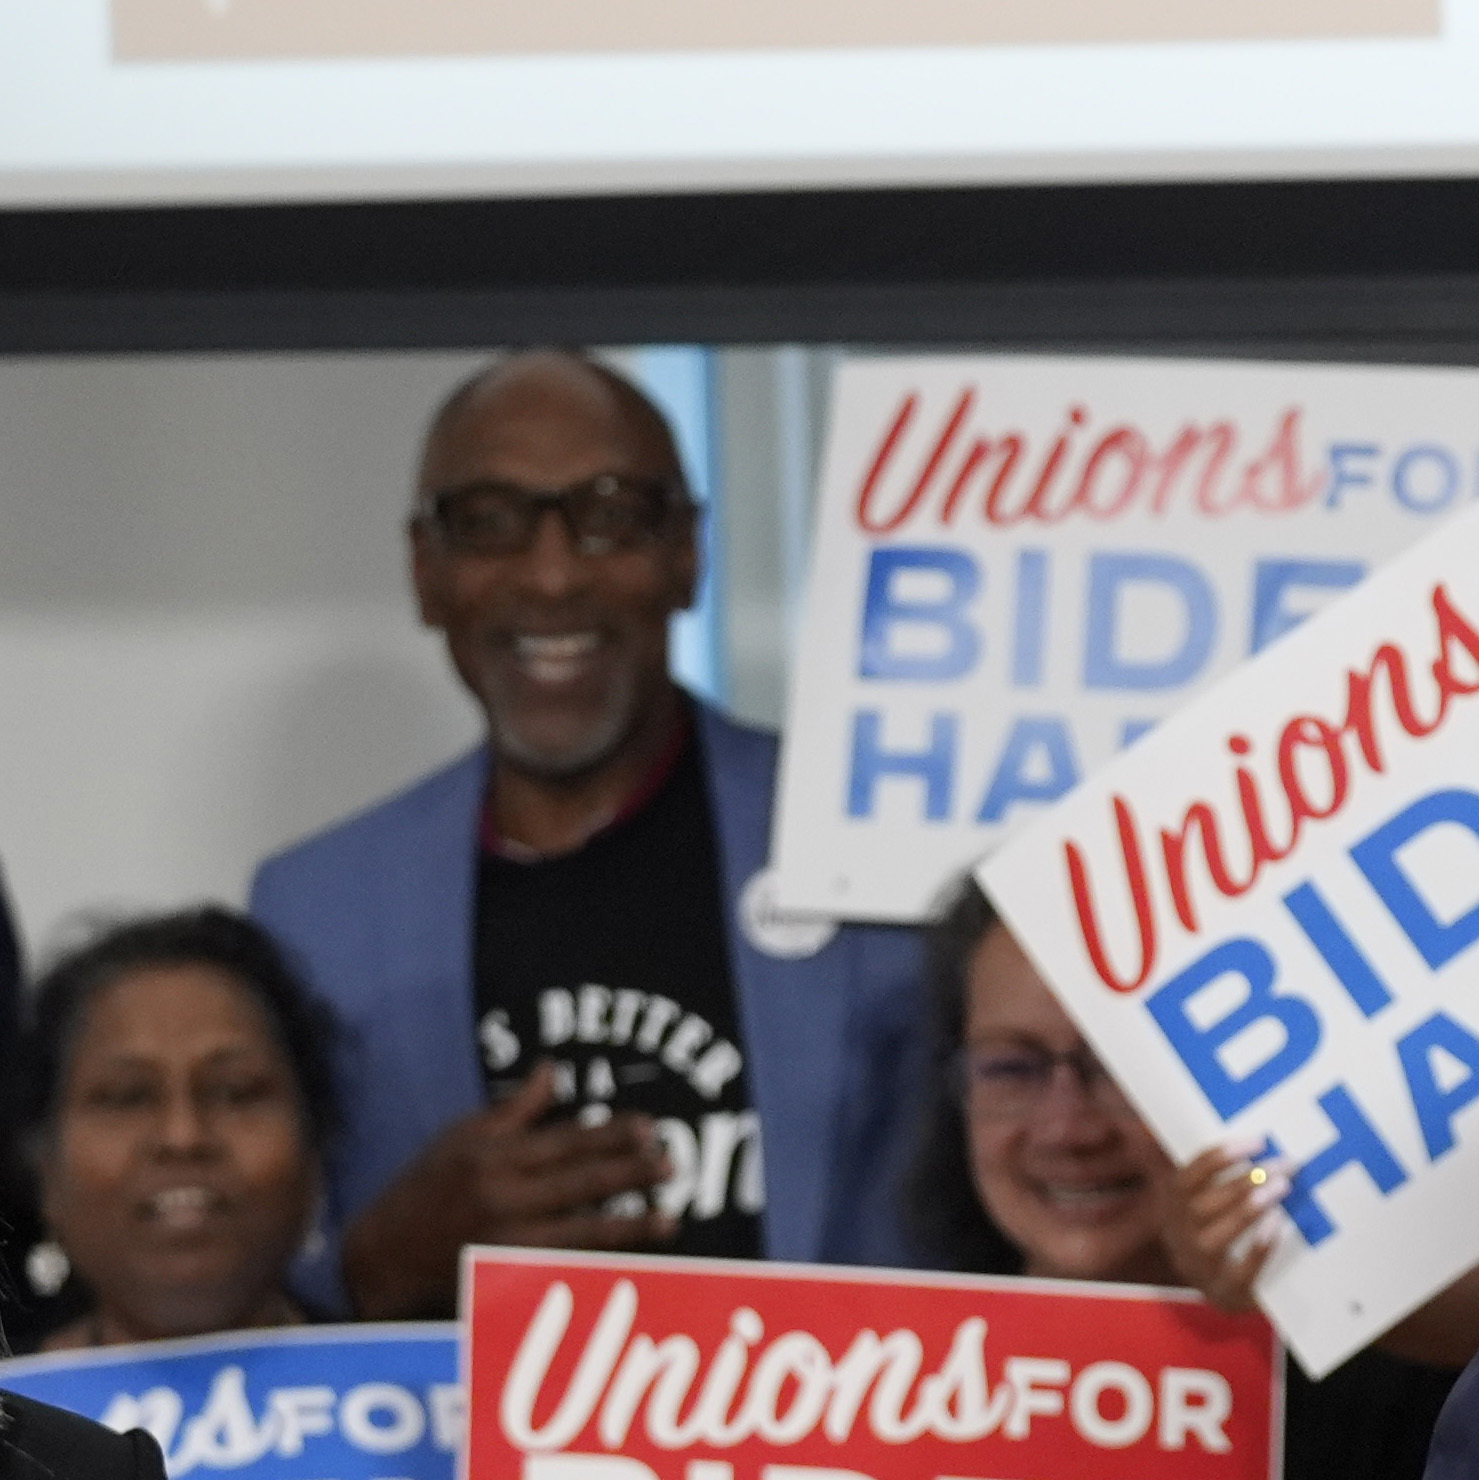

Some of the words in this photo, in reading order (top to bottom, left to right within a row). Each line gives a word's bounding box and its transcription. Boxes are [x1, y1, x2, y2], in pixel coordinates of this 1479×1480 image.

[854, 383, 1327, 537] Unions
[500, 1278, 1012, 1452] Unions
[1004, 1355, 1233, 1453] FOR
